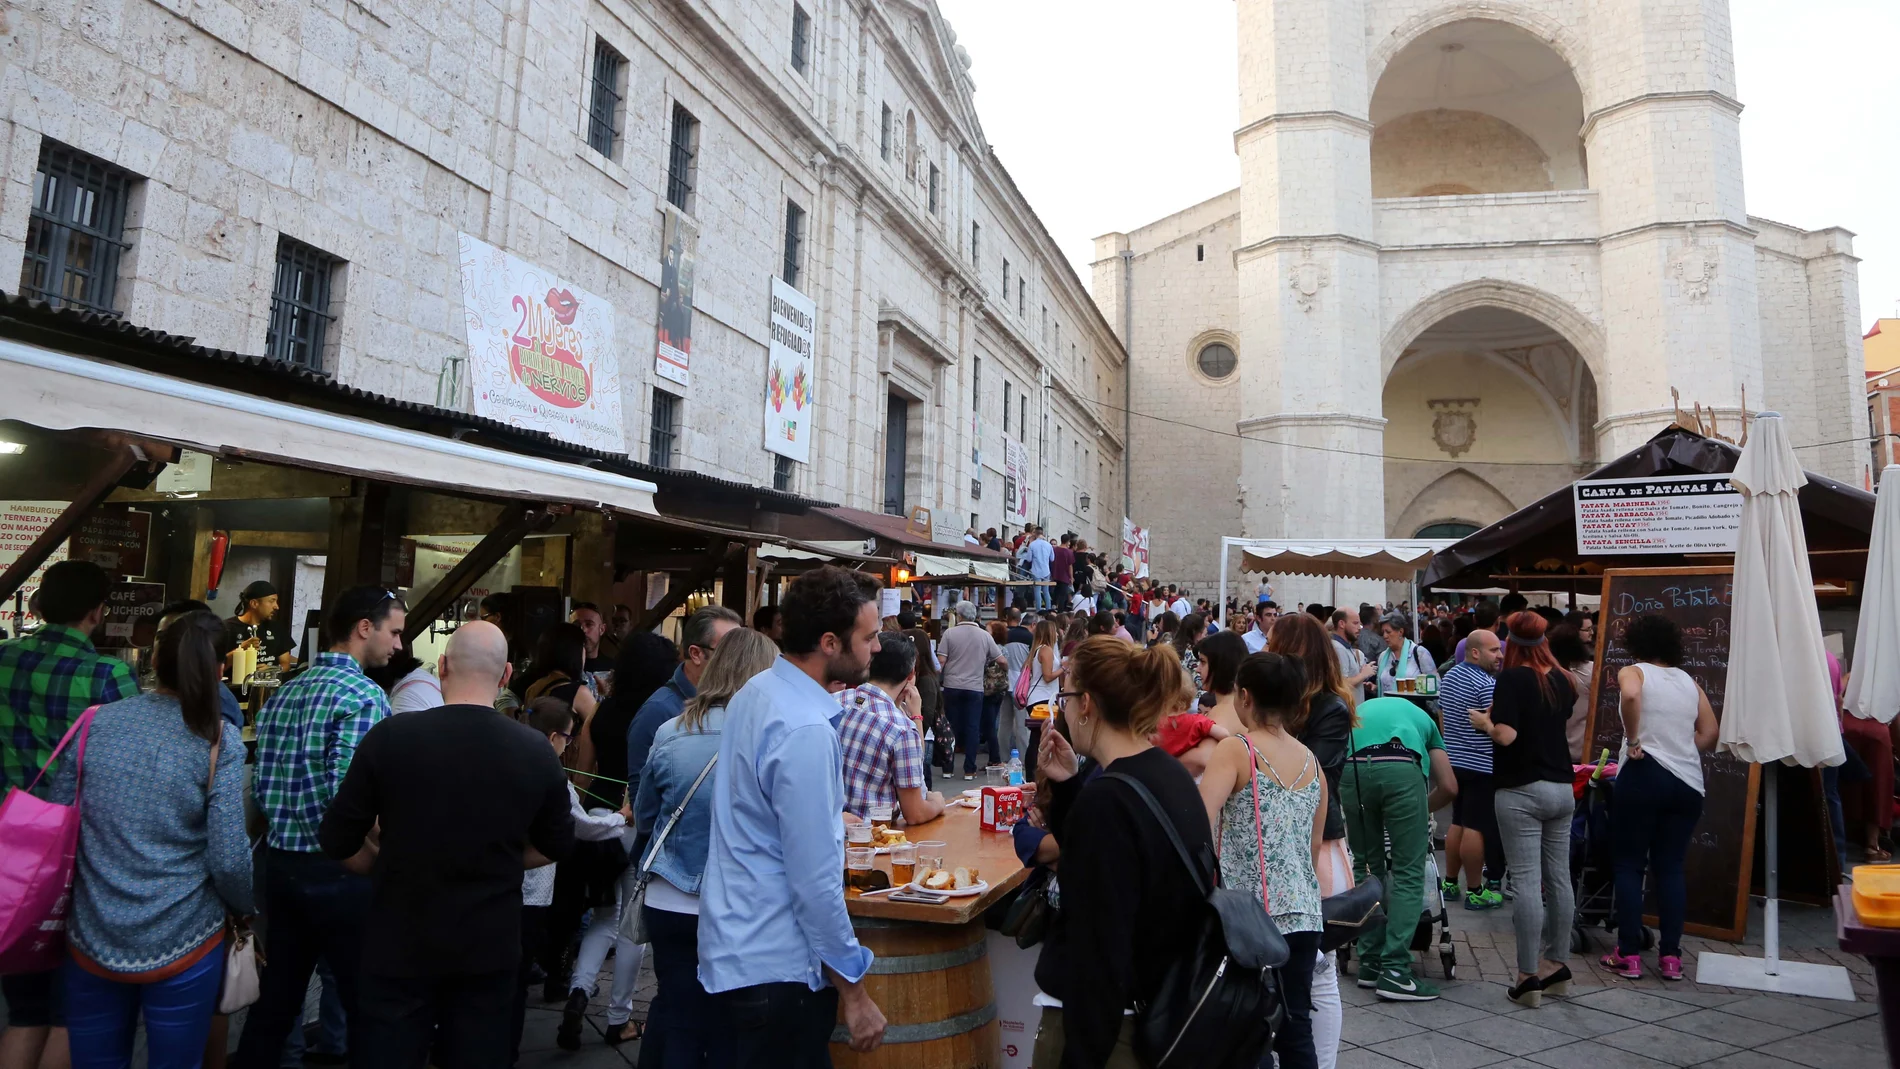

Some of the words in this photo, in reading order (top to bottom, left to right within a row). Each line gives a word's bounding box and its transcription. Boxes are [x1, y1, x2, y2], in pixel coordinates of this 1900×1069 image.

[512, 295, 532, 347] 2
[528, 296, 583, 361] Mujeres
[532, 371, 588, 403] NERVIOS
[1582, 488, 1626, 497] CARTA
[1645, 484, 1707, 495] PATATAS
[3, 513, 42, 523] TERNERA
[15, 533, 33, 541] CON
[79, 536, 96, 545] CON
[110, 590, 136, 601] CAFÉ
[470, 587, 490, 597] VINO
[1613, 592, 1665, 616] Doña
[1662, 585, 1720, 607] Patata
[112, 605, 155, 616] UCHERO
